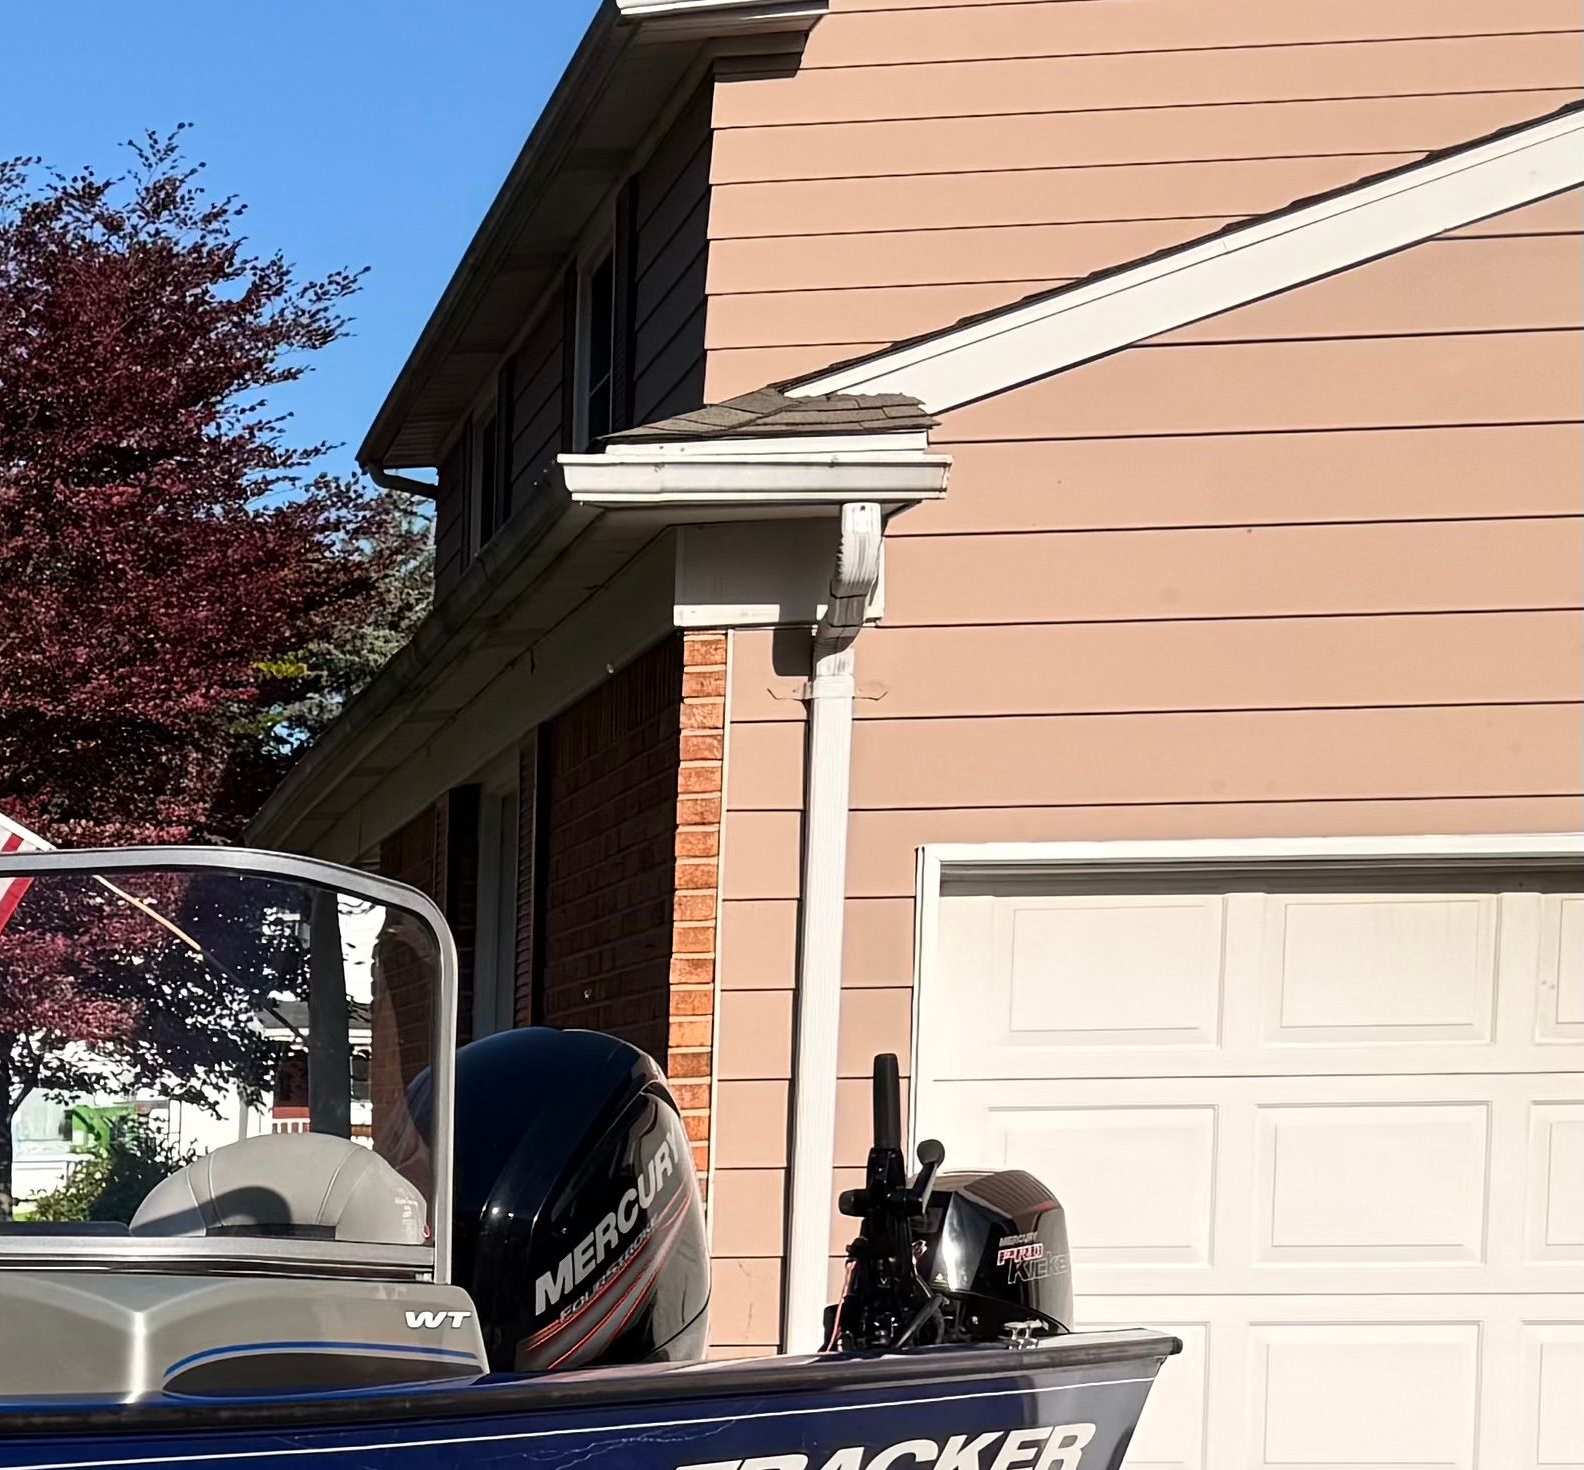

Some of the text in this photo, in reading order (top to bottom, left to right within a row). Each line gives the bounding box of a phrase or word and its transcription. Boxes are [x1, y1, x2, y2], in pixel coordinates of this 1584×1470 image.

[535, 1130, 679, 1316] MERCURY
[997, 1243, 1043, 1266] PRO
[405, 1311, 472, 1329] WT
